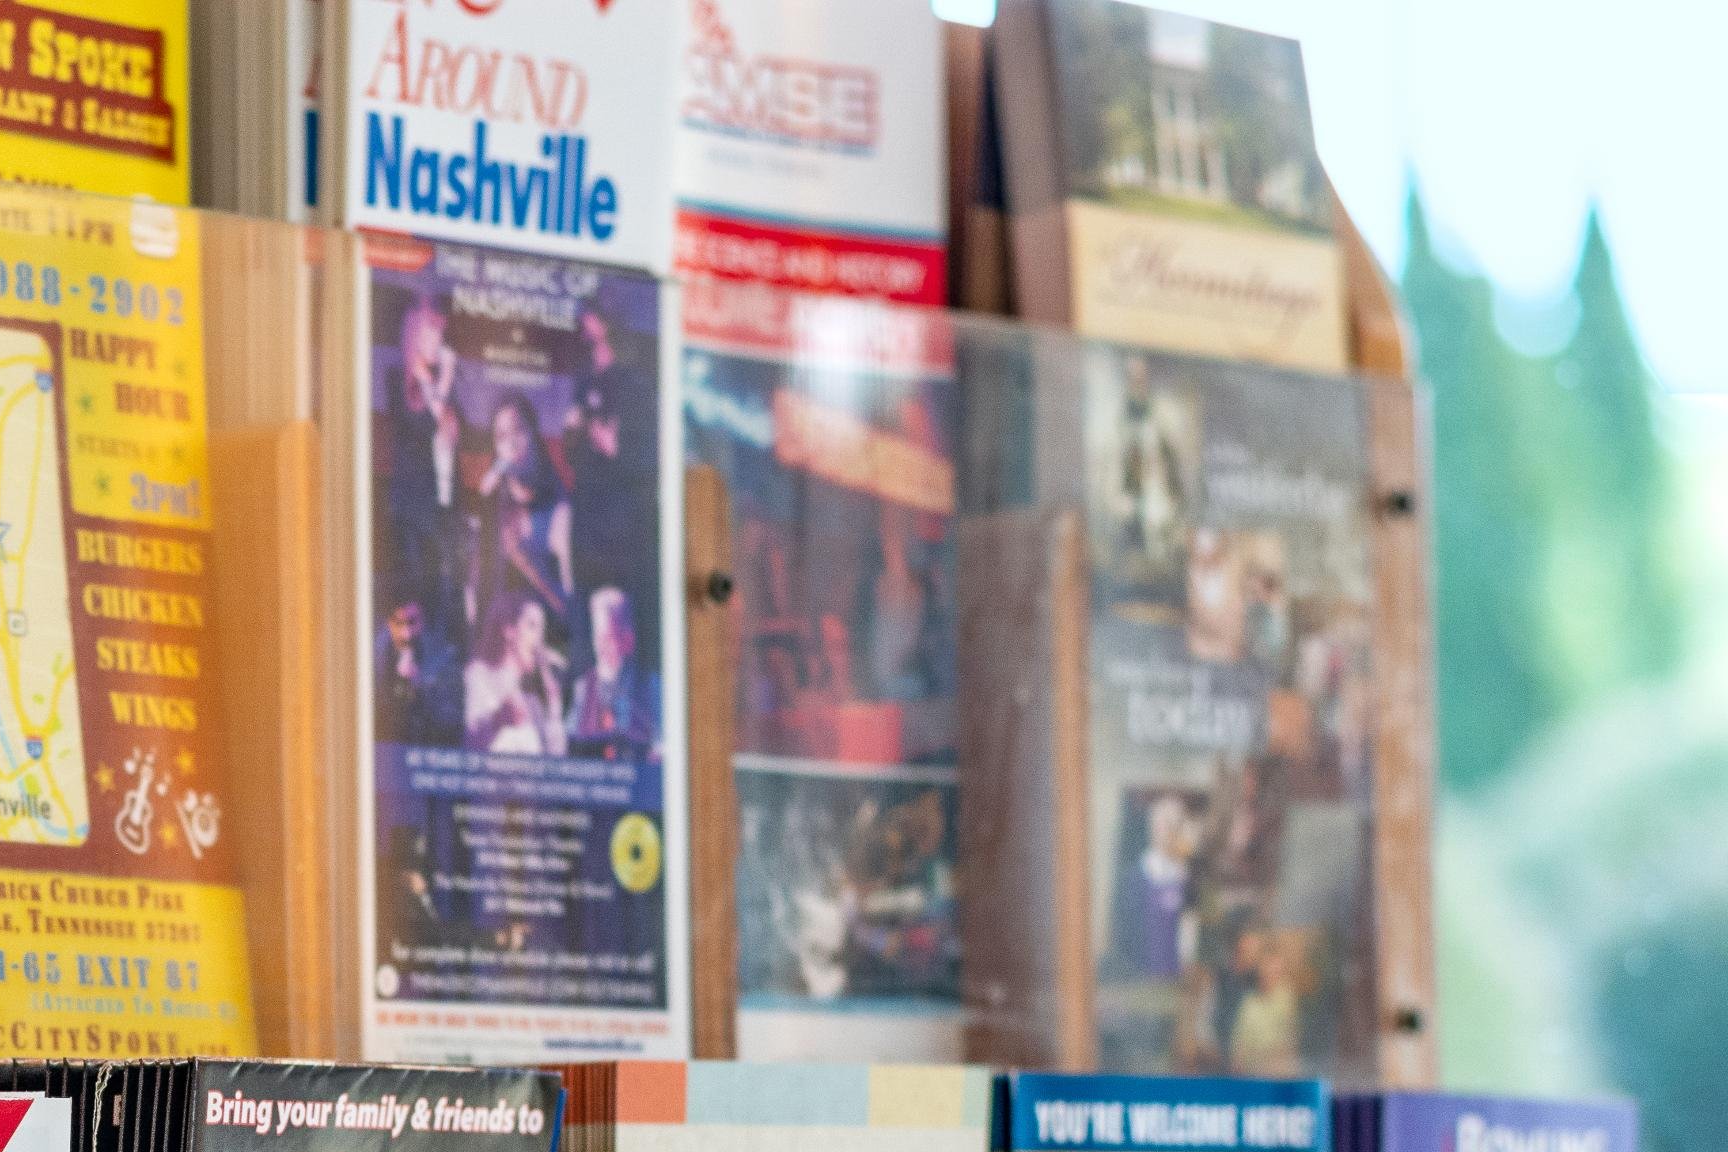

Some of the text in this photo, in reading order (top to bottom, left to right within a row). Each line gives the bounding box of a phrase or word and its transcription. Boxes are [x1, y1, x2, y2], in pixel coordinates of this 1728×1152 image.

[29, 18, 152, 98] SPOKE
[363, 8, 589, 129] AROUND
[365, 111, 617, 240] Nashville
[69, 327, 157, 371] HAPPY
[76, 529, 203, 575] BURGERS
[82, 583, 204, 628] CHICKEN
[96, 637, 200, 680] STEAKS
[109, 690, 198, 732] WINGS
[74, 952, 153, 991] EXIT
[205, 1090, 545, 1138] Bring your family & friends to
[1128, 1102, 1239, 1148] WELCOME
